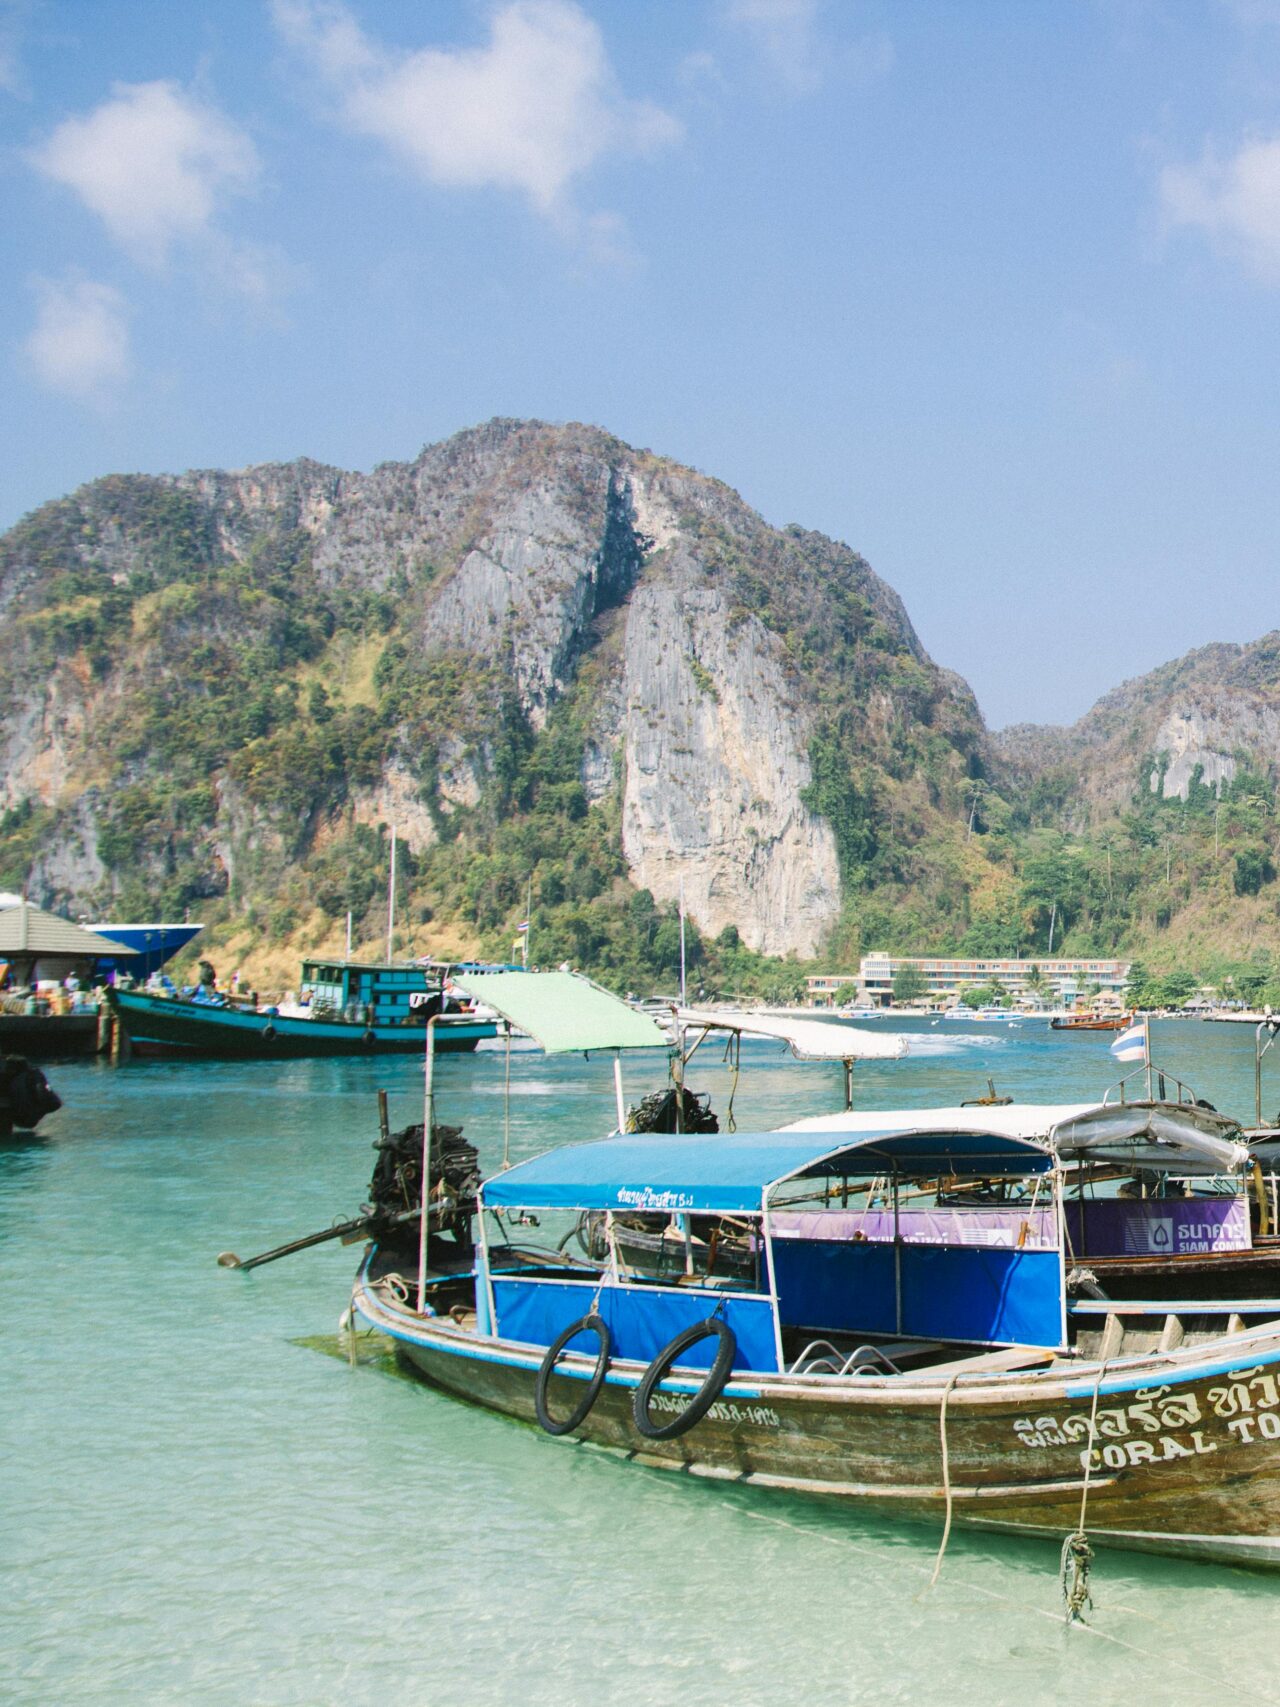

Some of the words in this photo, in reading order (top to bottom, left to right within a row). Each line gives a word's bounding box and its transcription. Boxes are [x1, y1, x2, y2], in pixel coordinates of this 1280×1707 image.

[1178, 1223, 1246, 1239] ธนาคาร
[1179, 1242, 1208, 1252] SIAM
[1080, 1431, 1217, 1471] CORAL
